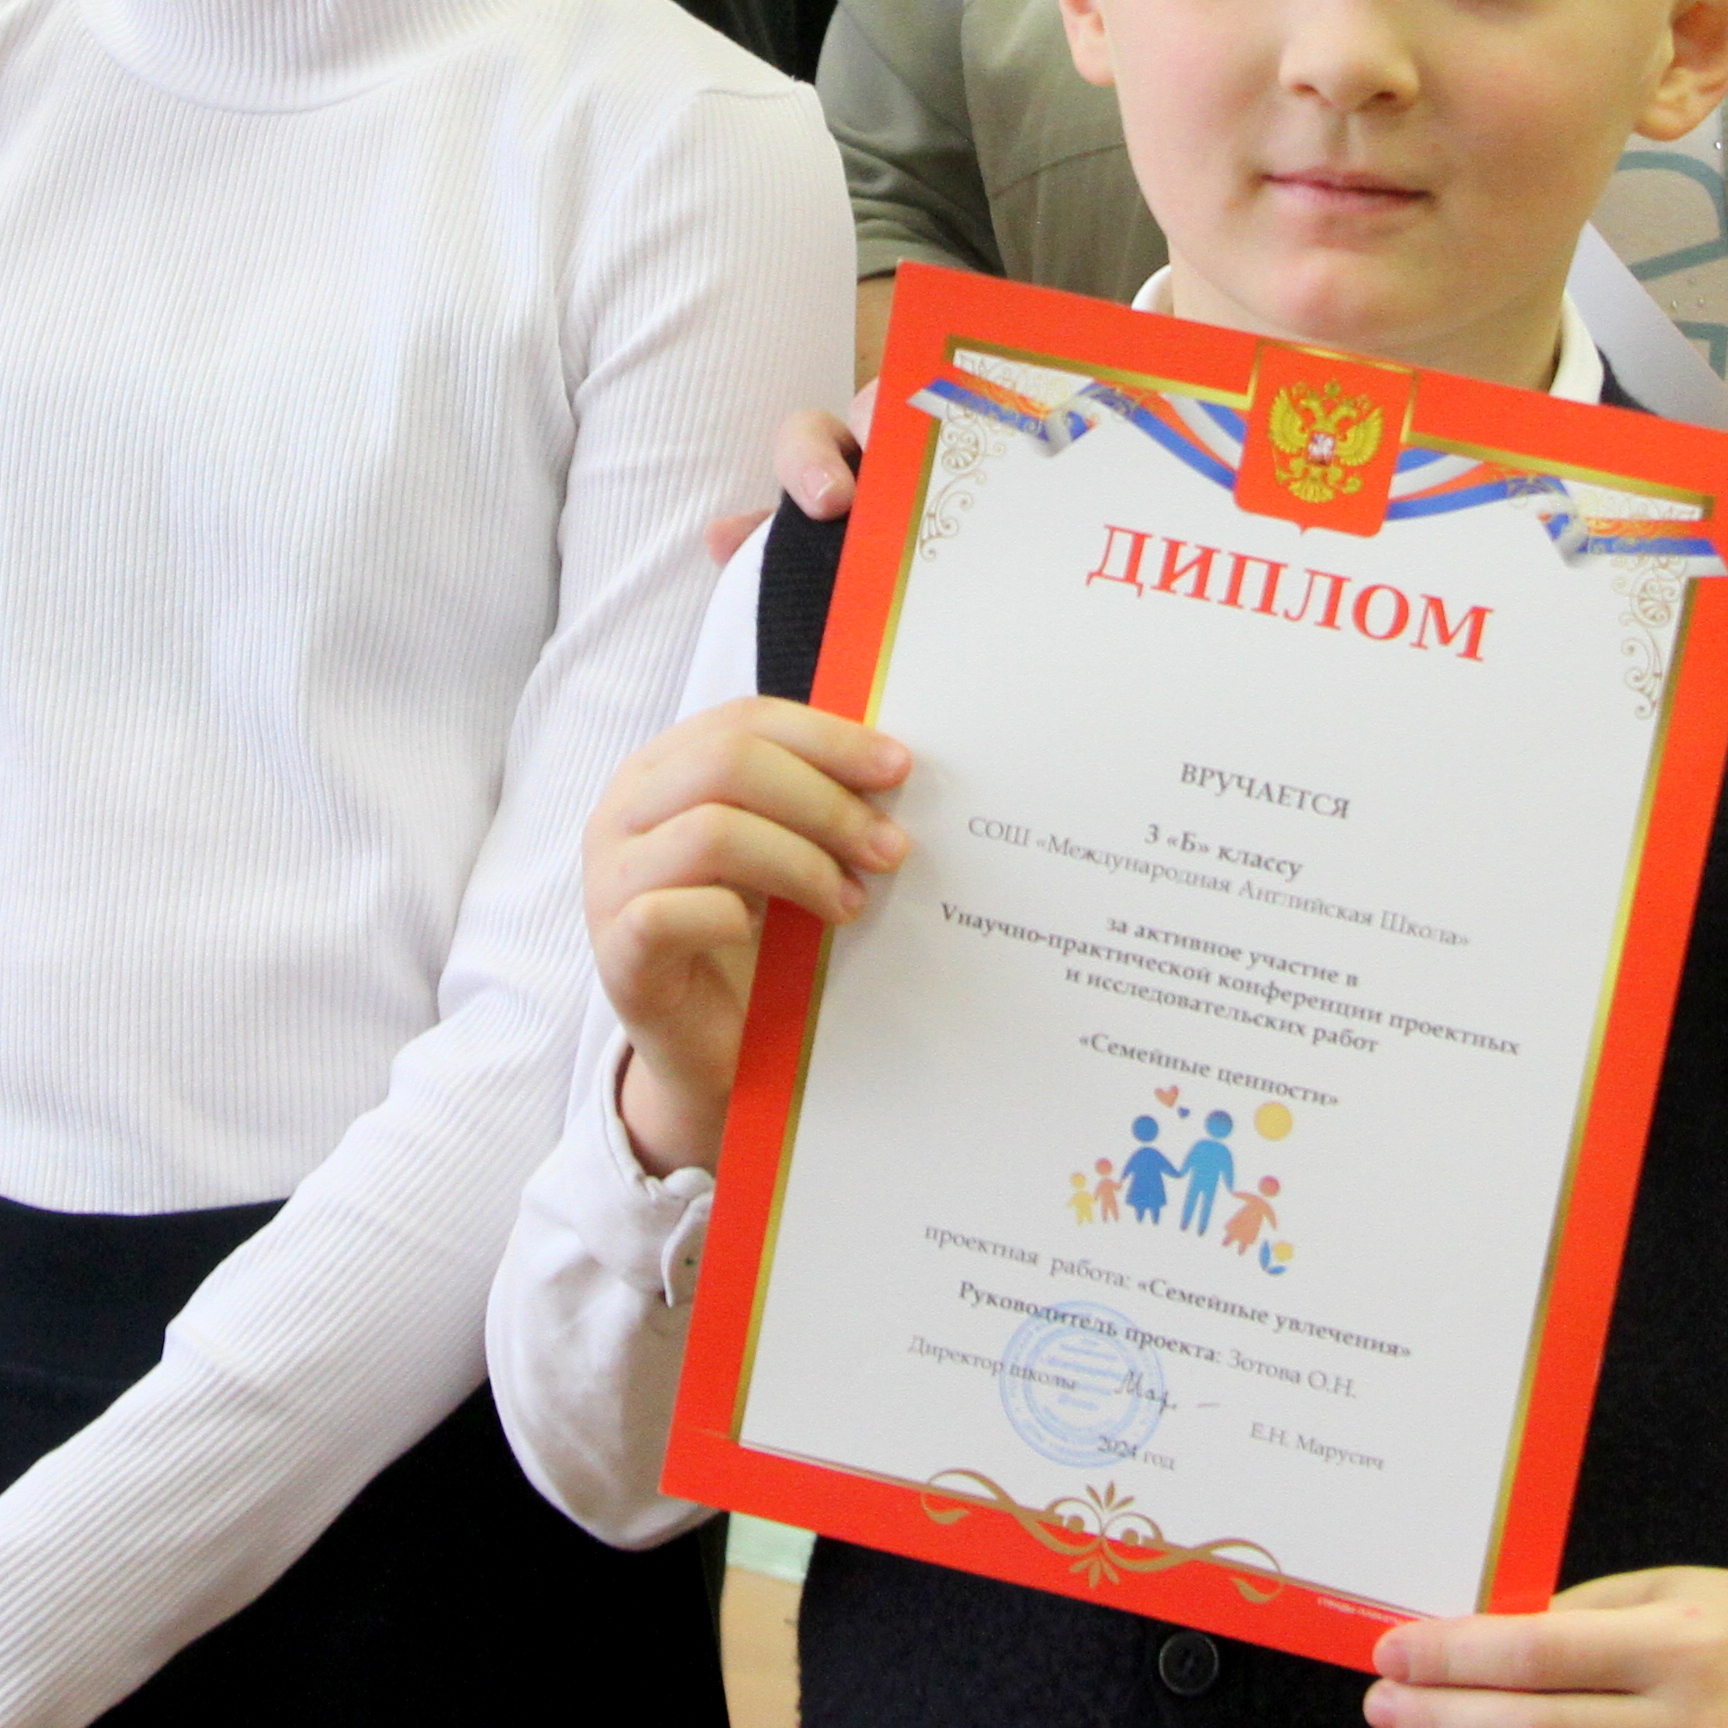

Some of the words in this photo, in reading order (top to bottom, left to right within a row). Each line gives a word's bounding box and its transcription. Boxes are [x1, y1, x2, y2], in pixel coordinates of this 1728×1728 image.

[1086, 524, 1494, 663] ДИПЛОМ
[1180, 762, 1350, 819] ВРУЧАЕТСЯ
[968, 816, 1031, 847] СОШ
[1035, 832, 1231, 894] «Международная
[1238, 879, 1374, 927] Английская
[1380, 908, 1469, 947] Школа»
[1144, 823, 1160, 845] 3
[1166, 829, 1210, 855] «Б»
[1216, 844, 1303, 883] классу
[1106, 917, 1128, 934] за
[1134, 924, 1242, 961] активное
[1246, 949, 1340, 983] участие
[1346, 973, 1359, 988] в
[1065, 967, 1081, 984] и
[1087, 973, 1306, 1037] исследовательских
[1312, 1025, 1380, 1054] работ
[1217, 972, 1383, 1024] конференции
[1388, 1012, 1521, 1056] проектных
[1078, 1032, 1211, 1079] «Семейные
[1217, 1067, 1339, 1108] ценности»
[924, 1226, 1039, 1266] проектная
[1049, 1255, 1131, 1290] работа:
[1138, 1277, 1269, 1324] «Семейные
[1273, 1314, 1411, 1357] увлечения»
[907, 1334, 1005, 1376] Директор
[1009, 1363, 1077, 1390] школы
[959, 1280, 1118, 1337] Руководитель
[1125, 1326, 1221, 1364] проекта:
[1227, 1348, 1301, 1385] Зотова
[1308, 1370, 1357, 1399] О.Н.
[1144, 1450, 1176, 1471] год
[1295, 1434, 1384, 1470] Марусич
